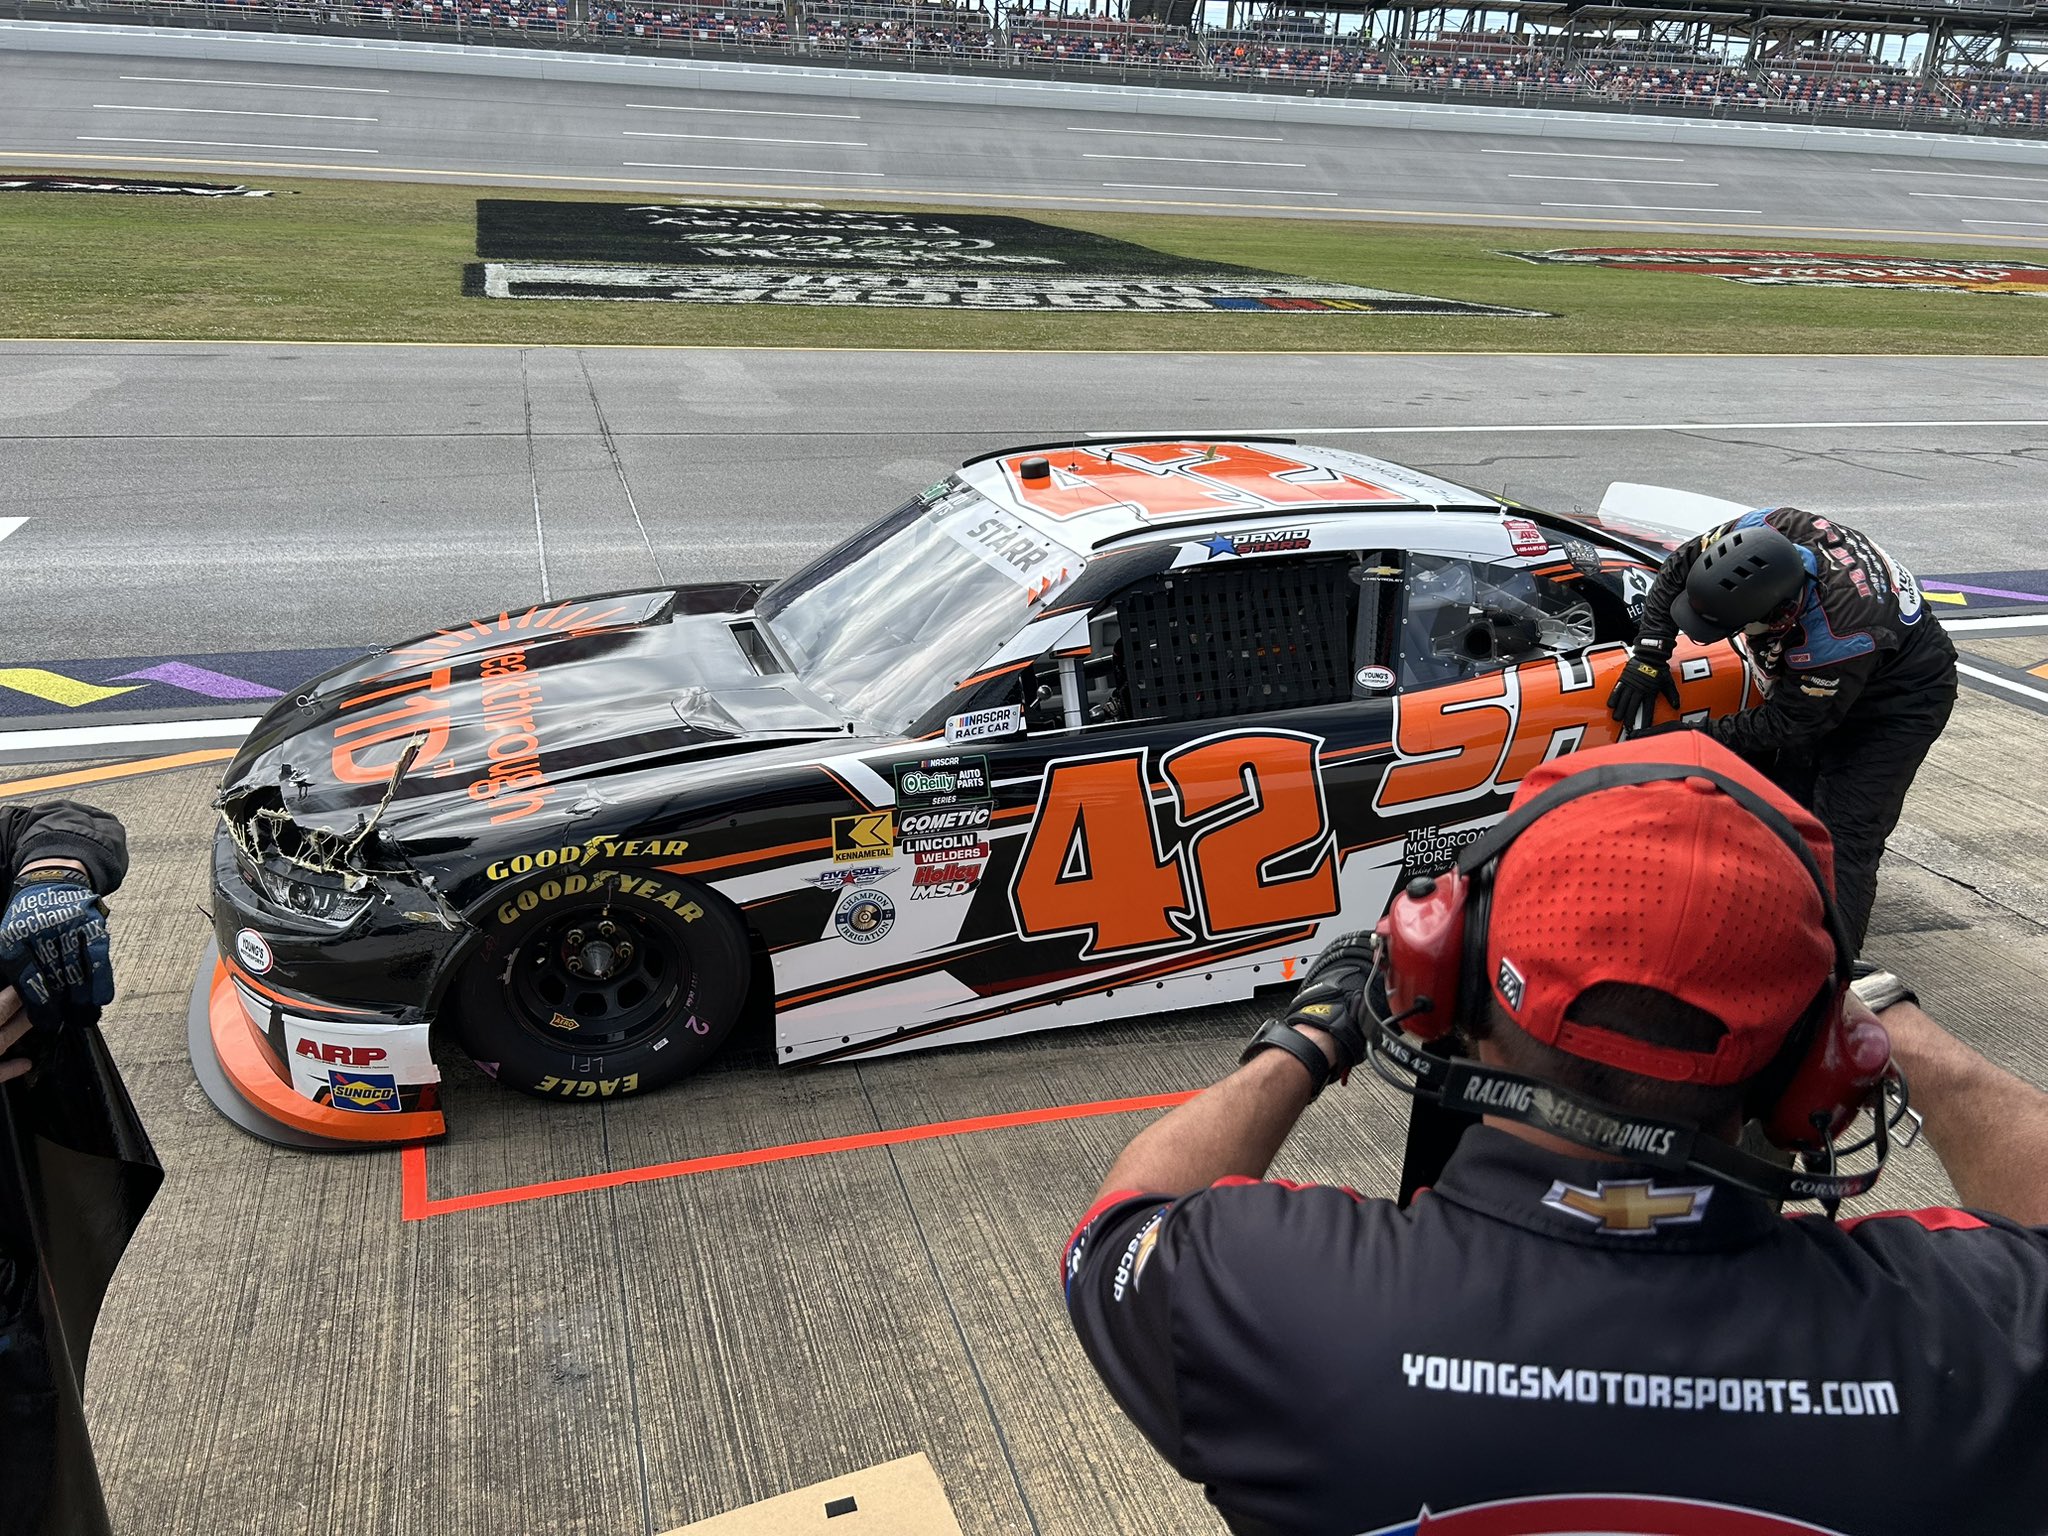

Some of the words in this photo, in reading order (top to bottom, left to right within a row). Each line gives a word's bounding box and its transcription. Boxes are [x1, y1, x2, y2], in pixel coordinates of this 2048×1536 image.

[672, 286, 1215, 309] NASCAR
[1233, 529, 1310, 544] DAVID
[1519, 530, 1540, 540] ATS
[965, 517, 1049, 575] STARR
[1236, 540, 1311, 554] STARR
[1364, 671, 1389, 680] YOUNG'S
[331, 666, 451, 784] T1D
[969, 708, 1011, 727] NASCAR
[956, 725, 984, 739] RACE
[987, 721, 1010, 733] CAR
[930, 757, 960, 767] NASCAR
[903, 771, 957, 794] O'Reilly
[957, 777, 984, 789] PARTS
[959, 769, 981, 780] AUTO
[932, 795, 957, 805] SERIES
[901, 808, 990, 833] COMETIC
[906, 834, 974, 853] LINCOLN
[1007, 727, 1342, 960] 42
[1408, 826, 1437, 842] THE
[486, 836, 689, 881] GOODYEAR
[835, 849, 891, 862] KENNAMETAL
[921, 848, 981, 863] WELDERS
[1405, 848, 1453, 868] STORE
[820, 871, 847, 881] FIVE
[851, 866, 881, 876] STAR
[912, 863, 981, 886] Holley
[497, 870, 705, 925] GOODYEAR
[910, 880, 970, 901] MSD
[11, 887, 94, 919] Mechanix
[842, 892, 890, 911] CHAMPION
[0, 902, 86, 949] Mechanix
[841, 921, 890, 942] IRRIGATION
[242, 937, 264, 959] YOUNG'S
[554, 1016, 575, 1028] AERO
[295, 1037, 388, 1066] ARP
[1381, 1033, 1411, 1063] YMS
[1409, 1051, 1432, 1075] 42
[335, 1086, 393, 1099] SUNOCO
[534, 1072, 639, 1097] EAGLE
[1463, 1075, 1535, 1113] RACING
[1551, 1101, 1676, 1156] ELECTRONICS
